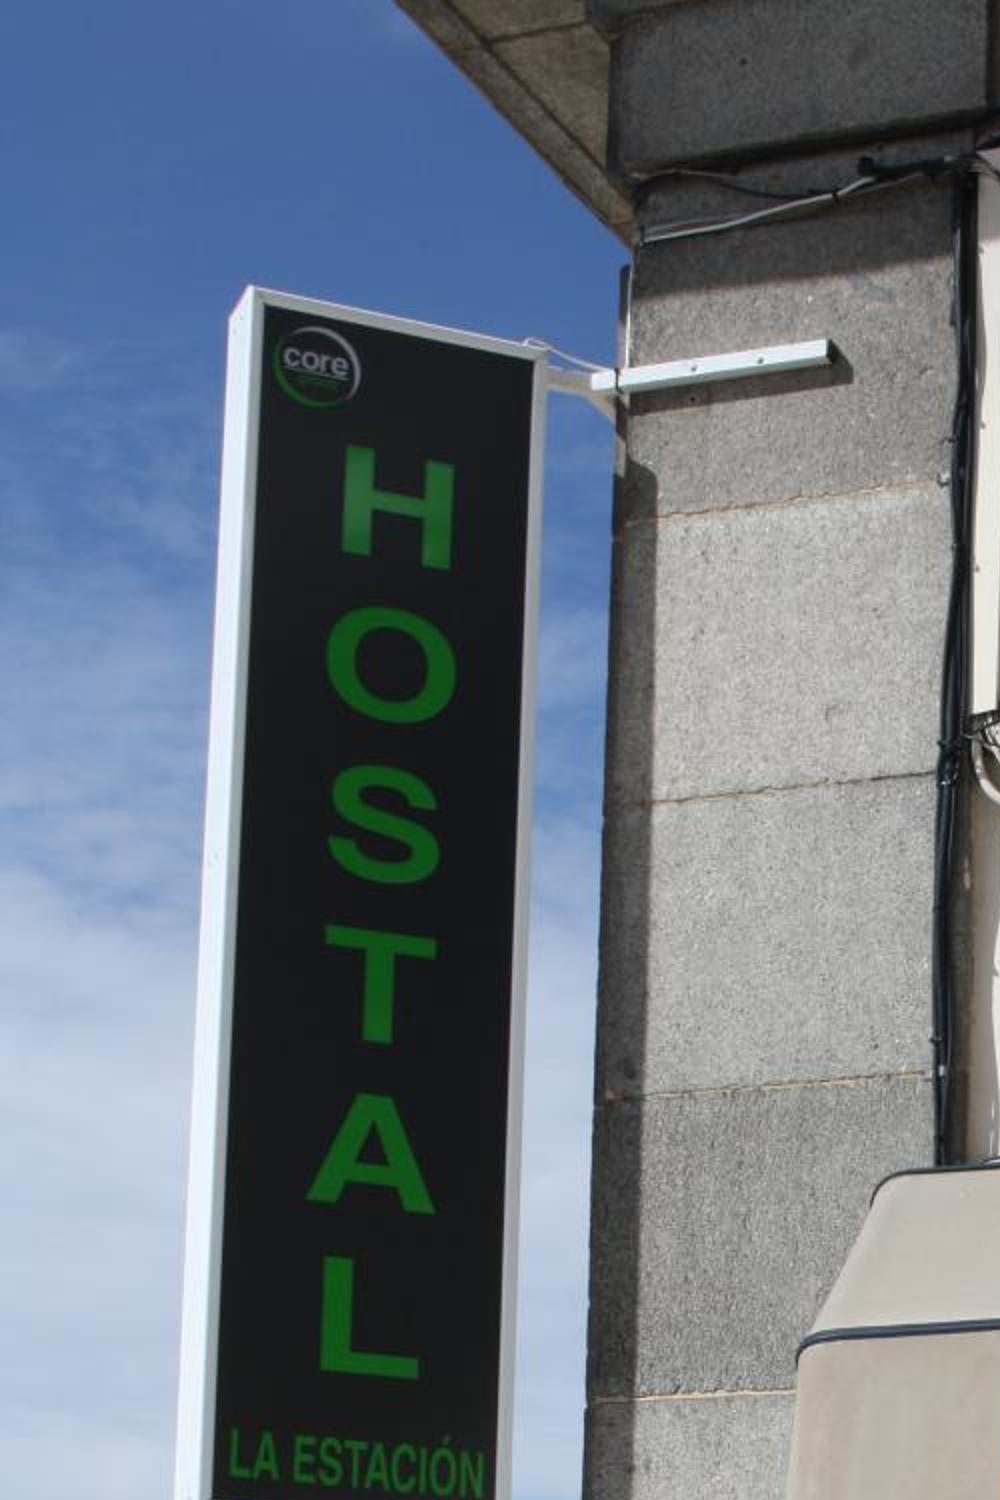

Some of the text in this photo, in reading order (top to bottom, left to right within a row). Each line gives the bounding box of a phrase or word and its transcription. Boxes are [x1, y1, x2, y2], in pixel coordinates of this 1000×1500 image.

[283, 346, 350, 376] core
[305, 444, 456, 1380] HOSTAL
[228, 1428, 485, 1500] LA ESTACIÓN
